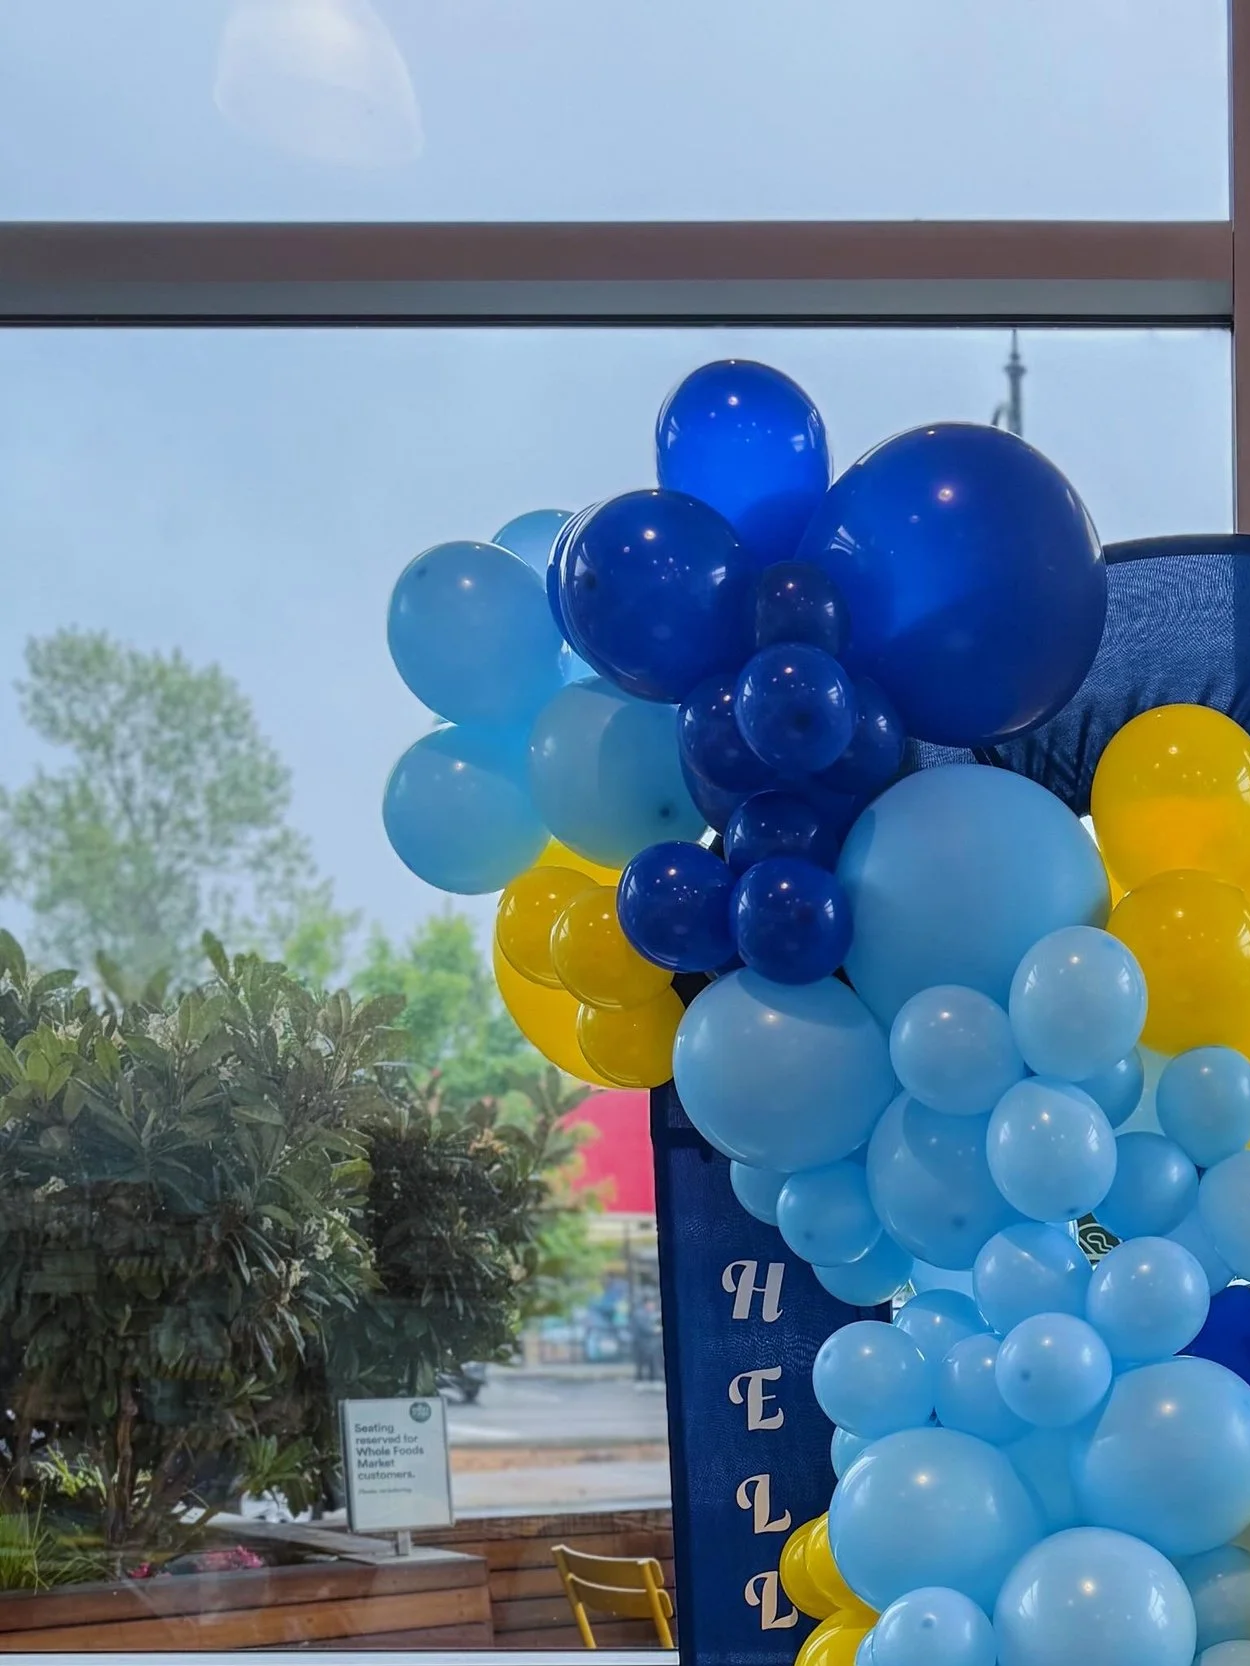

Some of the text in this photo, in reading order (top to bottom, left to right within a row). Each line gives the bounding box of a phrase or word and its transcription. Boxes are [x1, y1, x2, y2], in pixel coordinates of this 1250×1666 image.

[354, 1423, 394, 1434] Seating
[356, 1433, 419, 1445] reserved for
[356, 1445, 424, 1457] Whole Foods
[357, 1459, 395, 1469] Market
[358, 1471, 416, 1481] customers.
